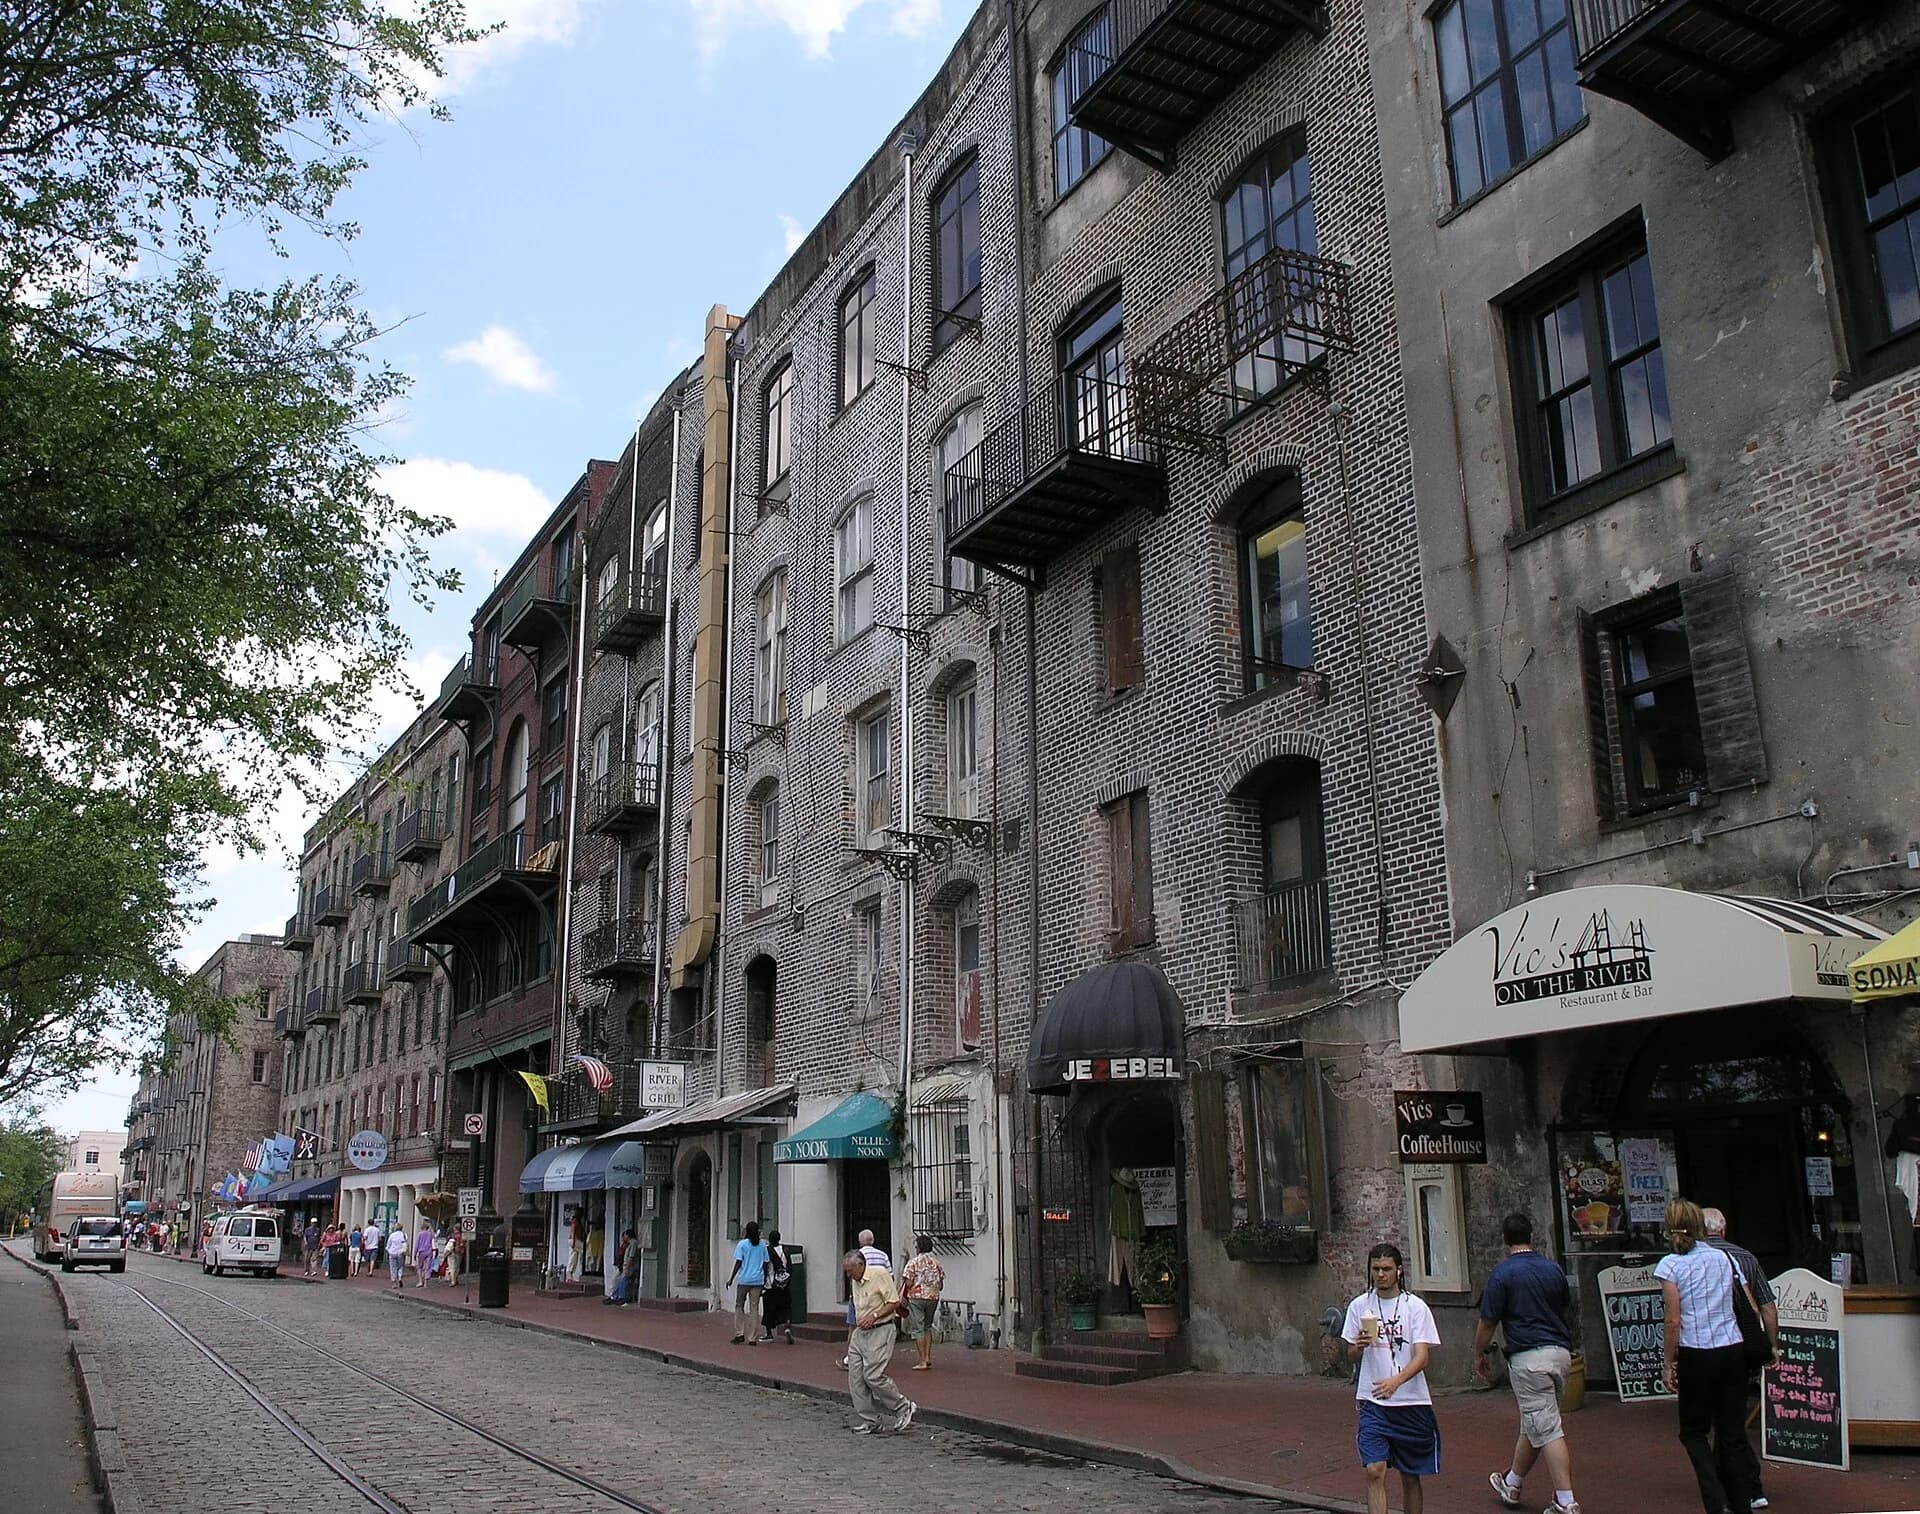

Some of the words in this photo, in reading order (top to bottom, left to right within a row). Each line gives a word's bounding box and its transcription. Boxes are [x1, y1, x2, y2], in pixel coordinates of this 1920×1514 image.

[1480, 910, 1567, 981] Vic's
[1496, 985, 1526, 1004] ON
[1534, 973, 1576, 996] THE
[1584, 961, 1650, 988] RIVER
[1818, 974, 1832, 984] ON
[1836, 975, 1849, 985] TH
[1560, 991, 1618, 1008] Restaurant
[1621, 988, 1630, 999] &
[1634, 985, 1653, 996] Bar
[656, 1066, 670, 1074] THE
[1062, 1057, 1180, 1081] JEZEBEL
[649, 1075, 678, 1085] RIVER
[649, 1094, 678, 1104] GRILL
[1398, 1099, 1433, 1124] Vic's
[795, 1140, 828, 1158] NOOK
[857, 1147, 885, 1156] NOOK
[1400, 1134, 1483, 1154] CoffeeHouse
[1135, 1168, 1173, 1178] JEZEBEL
[462, 1203, 476, 1215] 15
[1046, 1212, 1067, 1220] SALE
[1774, 1282, 1804, 1309] Vic's
[1607, 1294, 1665, 1322] COFFE
[1612, 1322, 1665, 1352] HOUS
[1787, 1347, 1815, 1361] Lunch
[1775, 1360, 1804, 1374] inner
[1621, 1380, 1650, 1397] ICE
[1787, 1390, 1808, 1402] the
[1810, 1390, 1836, 1406] BEST
[1773, 1404, 1798, 1419] View
[1799, 1407, 1808, 1418] in
